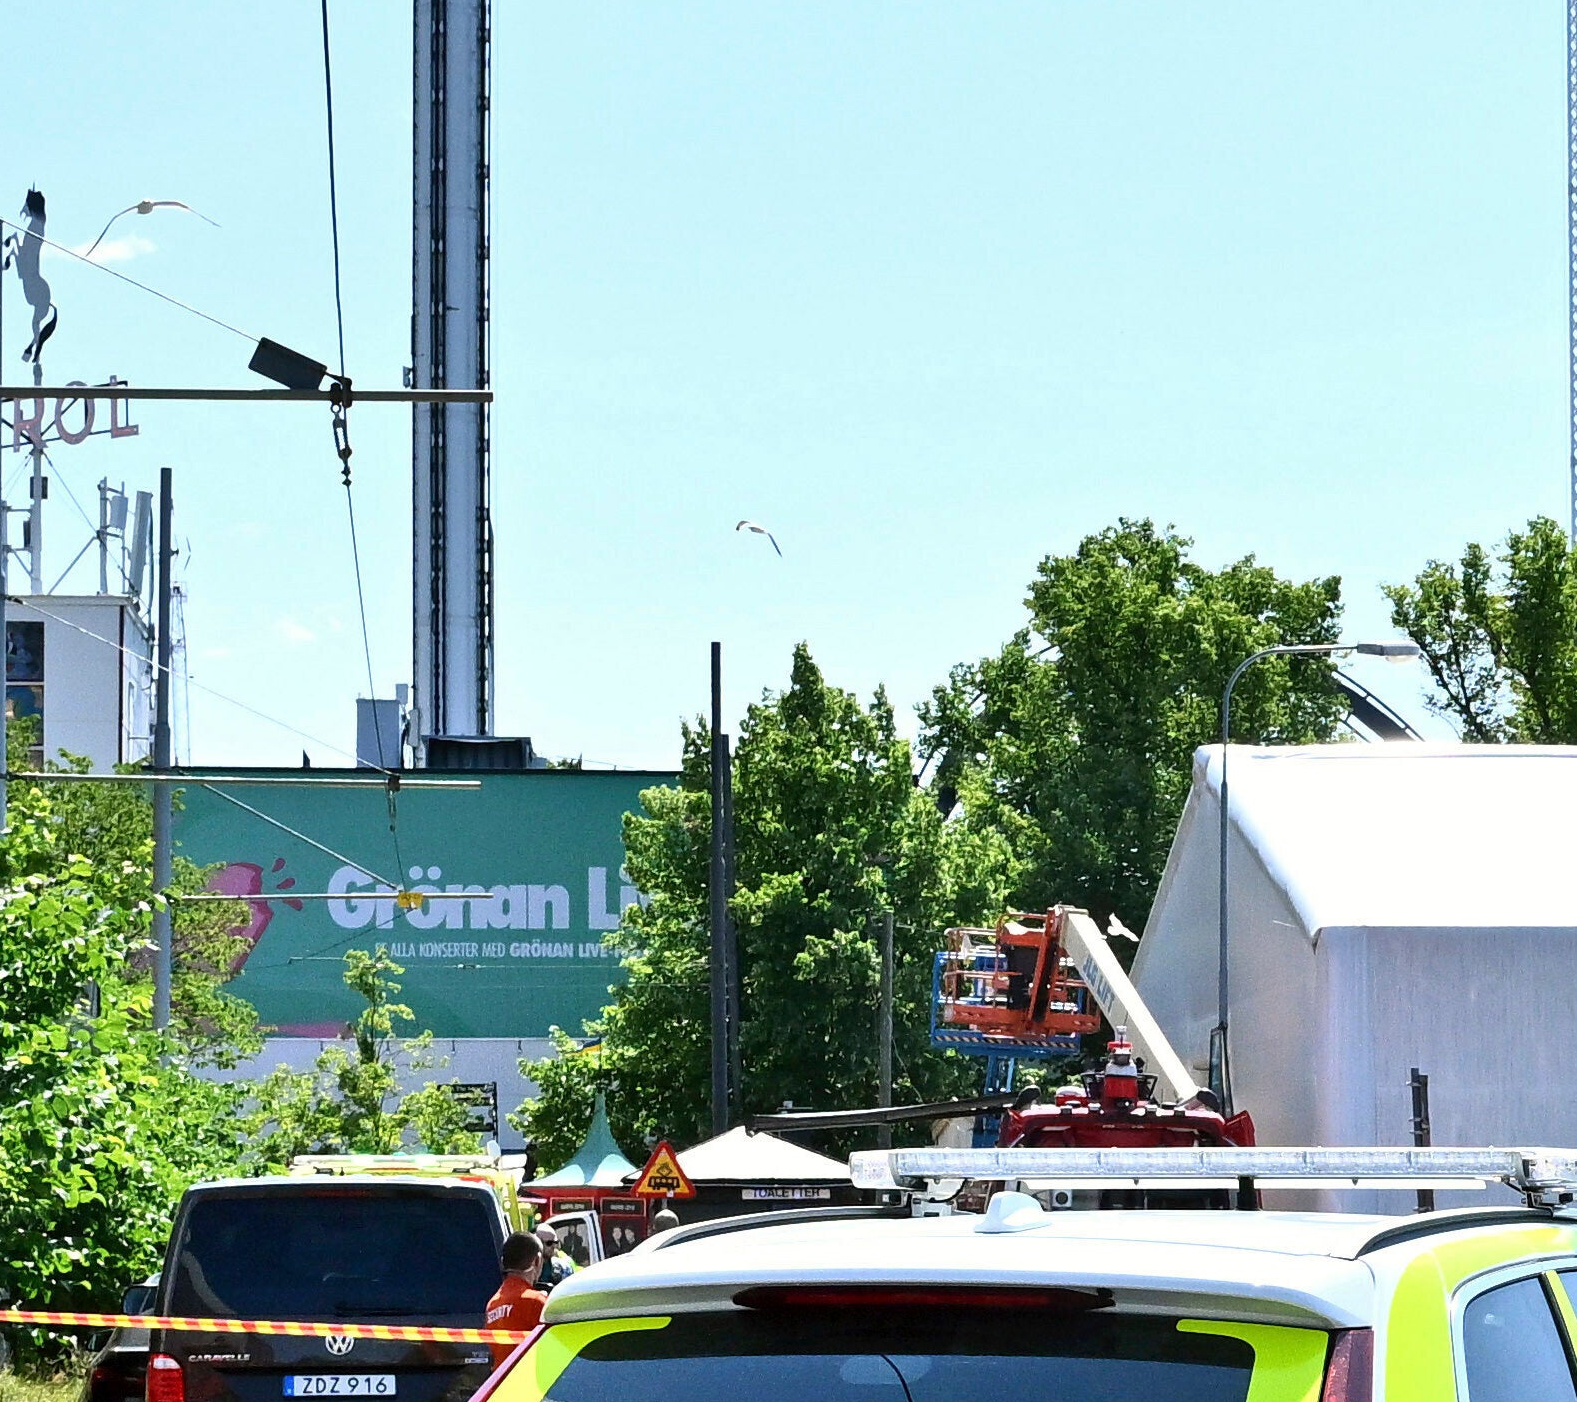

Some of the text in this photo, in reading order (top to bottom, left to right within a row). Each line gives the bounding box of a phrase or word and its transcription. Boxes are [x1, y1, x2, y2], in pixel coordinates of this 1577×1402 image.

[327, 865, 570, 929] Grönan
[390, 941, 416, 958] ALLA
[419, 941, 479, 958] KONSERTER
[482, 941, 506, 958] MED
[509, 938, 574, 958] GRÖNAN
[302, 1377, 388, 1395] ZDZ 916
